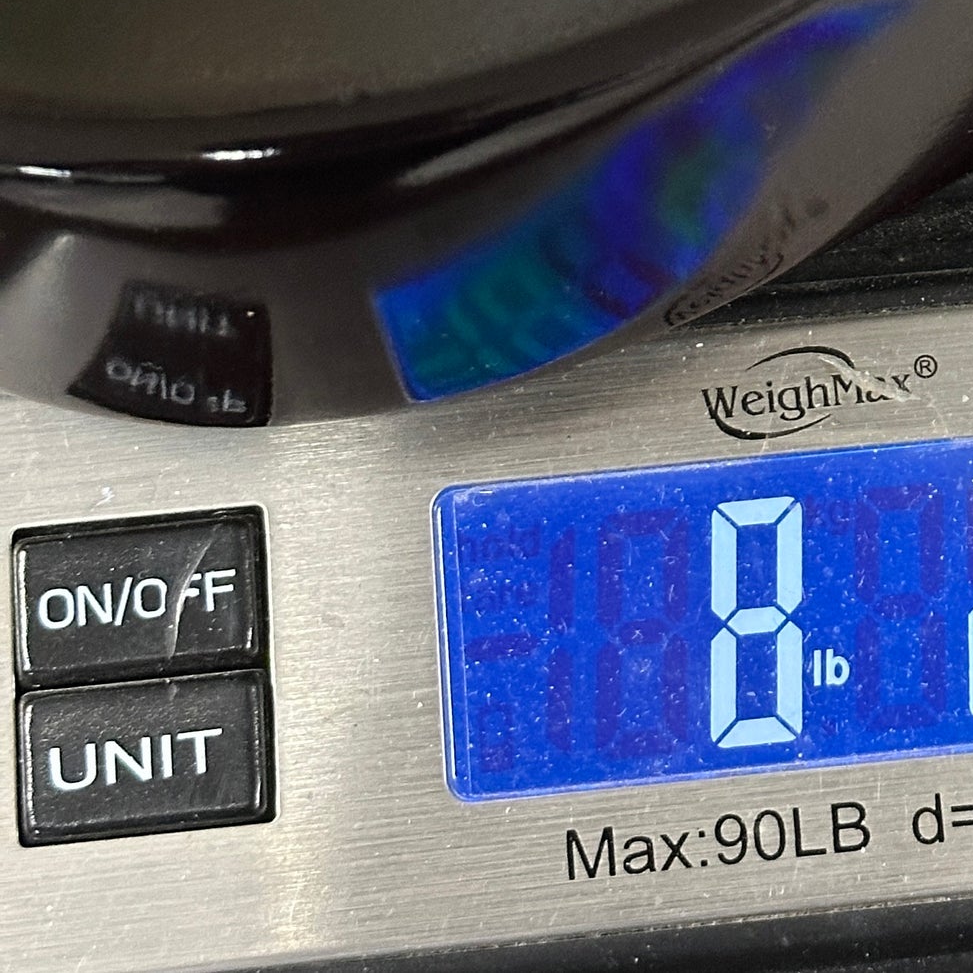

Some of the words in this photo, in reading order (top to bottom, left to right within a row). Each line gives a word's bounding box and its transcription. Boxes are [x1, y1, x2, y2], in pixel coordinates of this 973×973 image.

[710, 496, 803, 749] 8
[813, 648, 850, 688] lb
[47, 728, 223, 792] UNIT
[565, 801, 871, 881] Max:90LB
